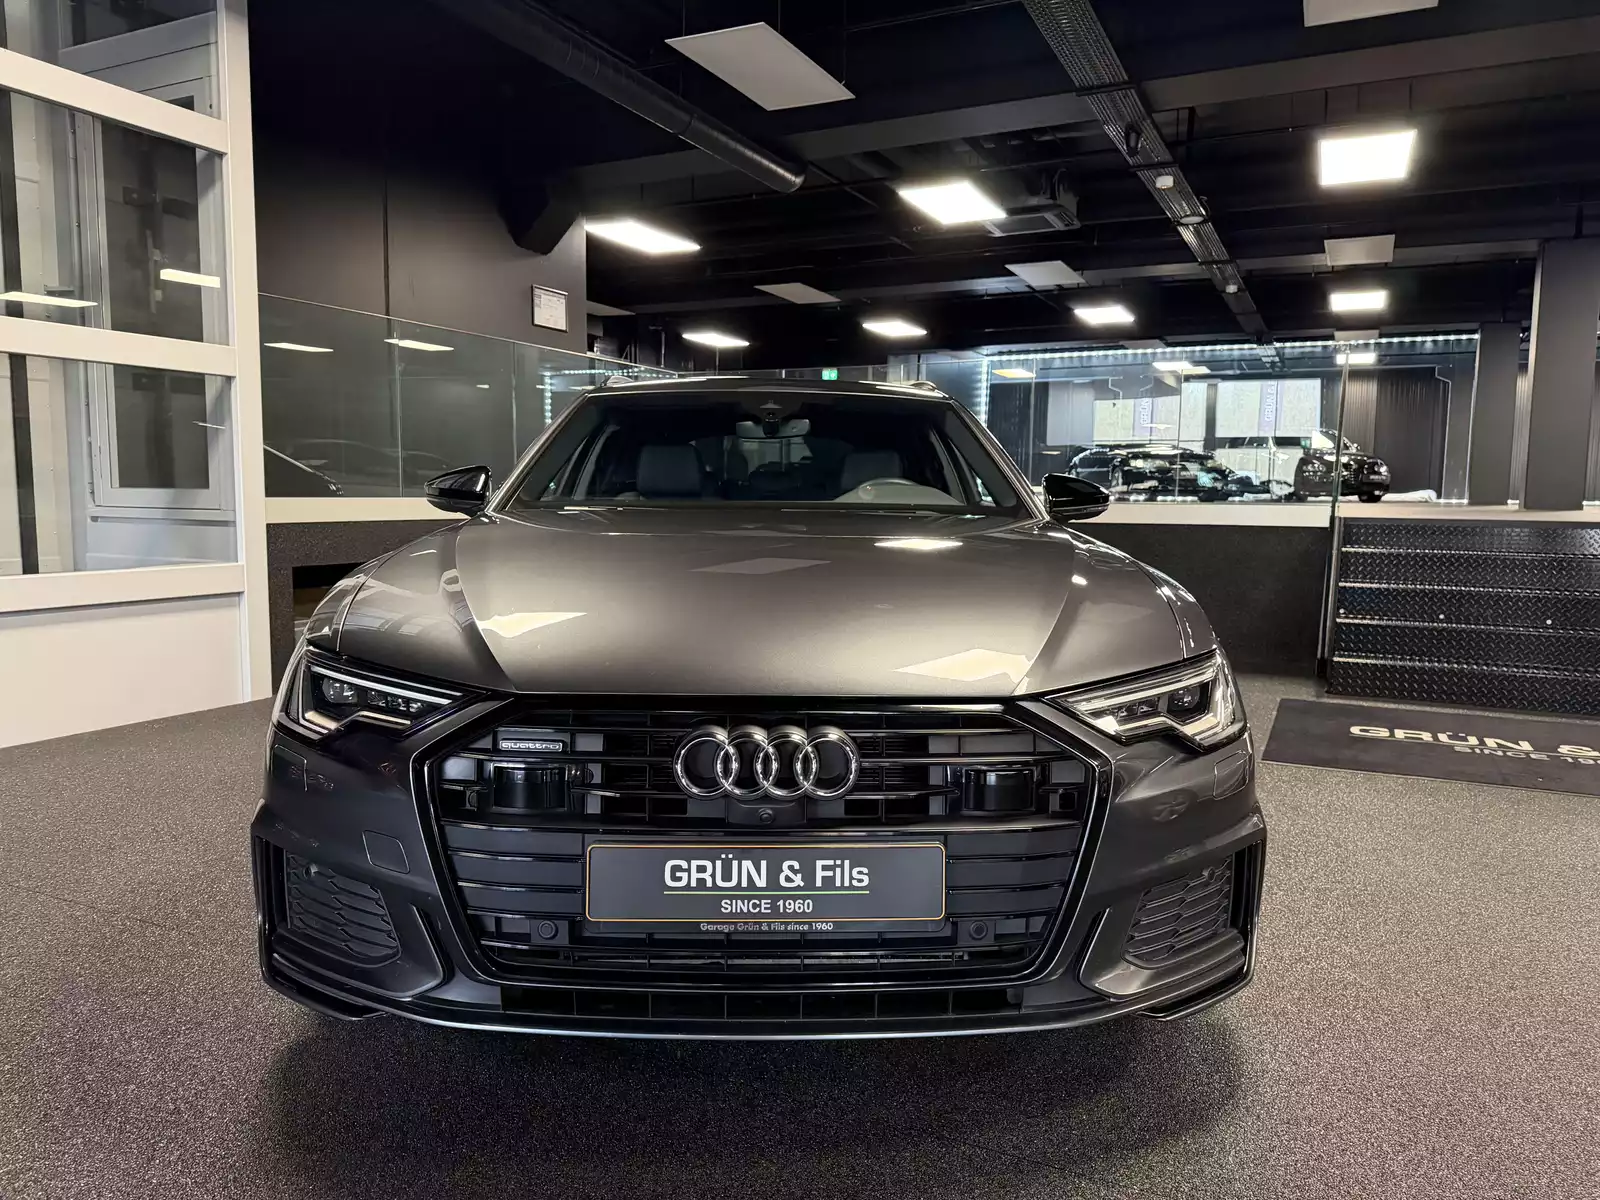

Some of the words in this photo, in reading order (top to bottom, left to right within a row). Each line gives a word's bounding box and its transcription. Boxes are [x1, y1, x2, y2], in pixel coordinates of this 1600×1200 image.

[501, 742, 560, 750] quattro
[1349, 725, 1535, 751] GRÜN
[1453, 746, 1551, 761] SINCE
[1559, 756, 1600, 765] 19
[664, 853, 767, 888] GRÜN
[779, 859, 805, 888] &
[815, 859, 870, 888] Fils
[720, 899, 772, 914] SINCE
[776, 899, 813, 914] 1960
[700, 922, 735, 933] Garage
[737, 921, 760, 931] Grün
[761, 922, 769, 931] &
[771, 922, 785, 931] Fils
[787, 922, 809, 931] since
[811, 922, 834, 931] 1960
